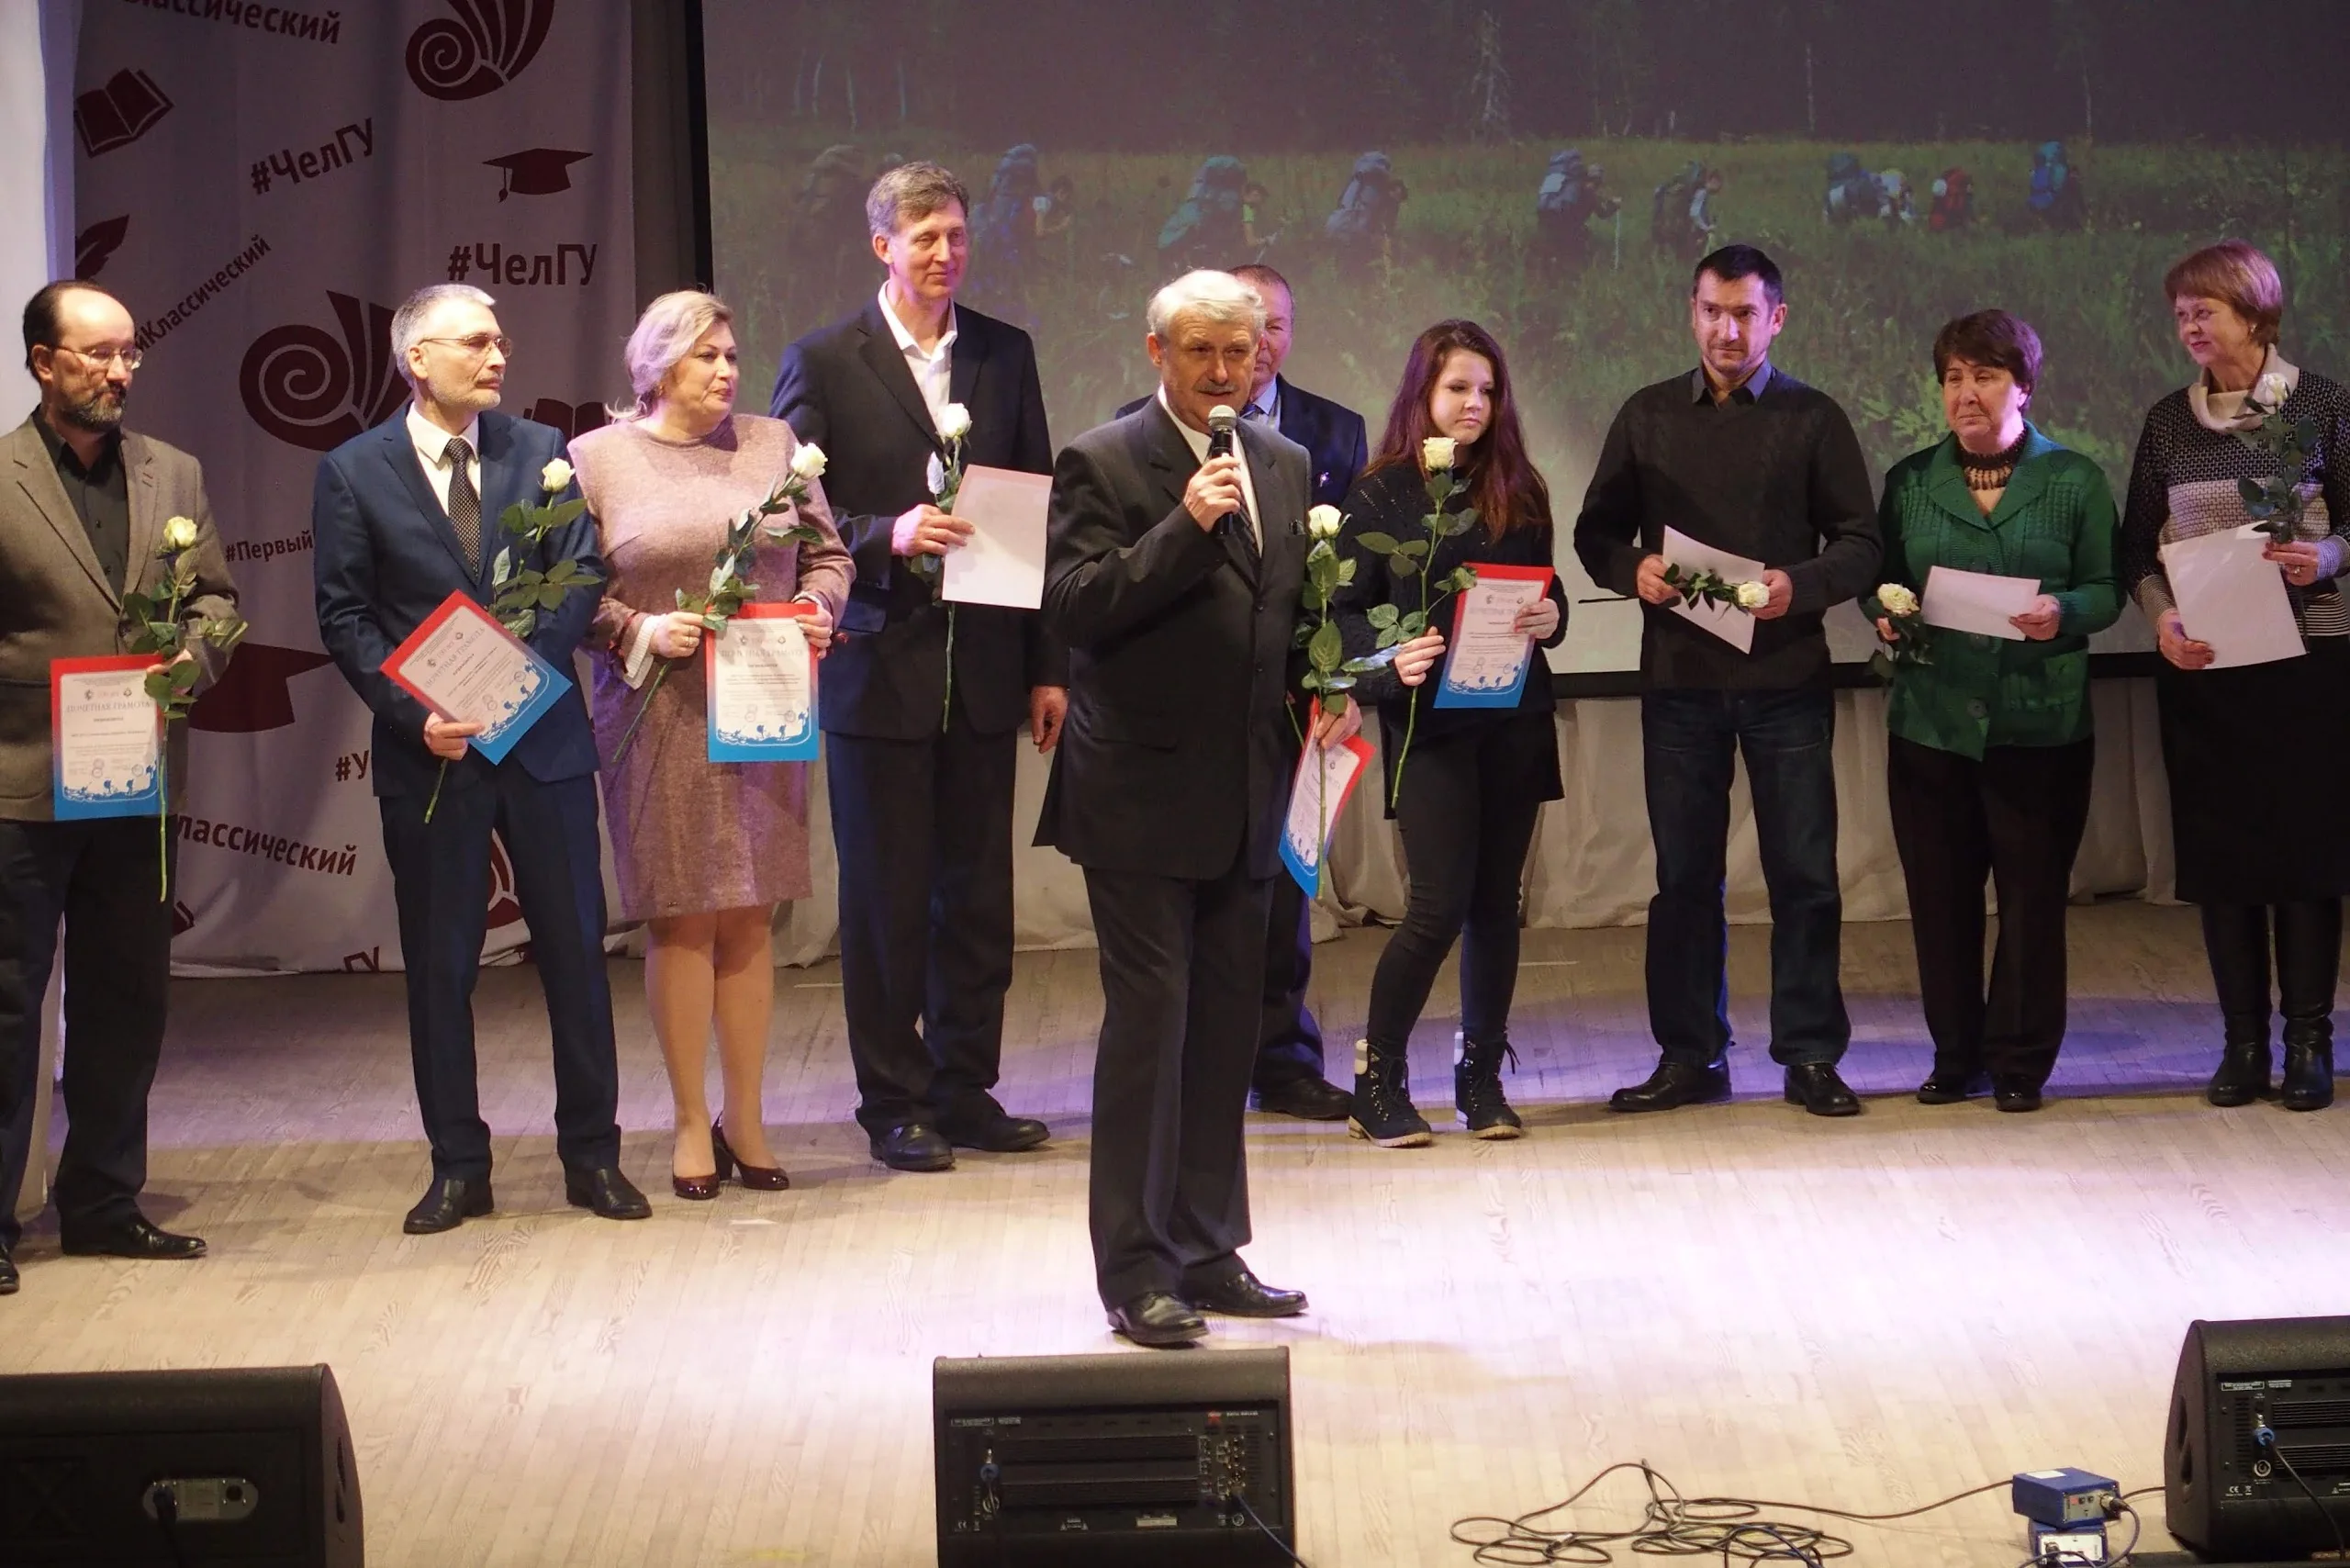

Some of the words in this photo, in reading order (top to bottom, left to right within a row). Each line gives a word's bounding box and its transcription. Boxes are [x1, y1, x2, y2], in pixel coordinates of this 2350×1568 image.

[125, 0, 341, 44] ассический
[251, 118, 373, 195] #ЧелГУ
[447, 242, 598, 286] #ЧелГУ
[226, 530, 313, 562] #Первый
